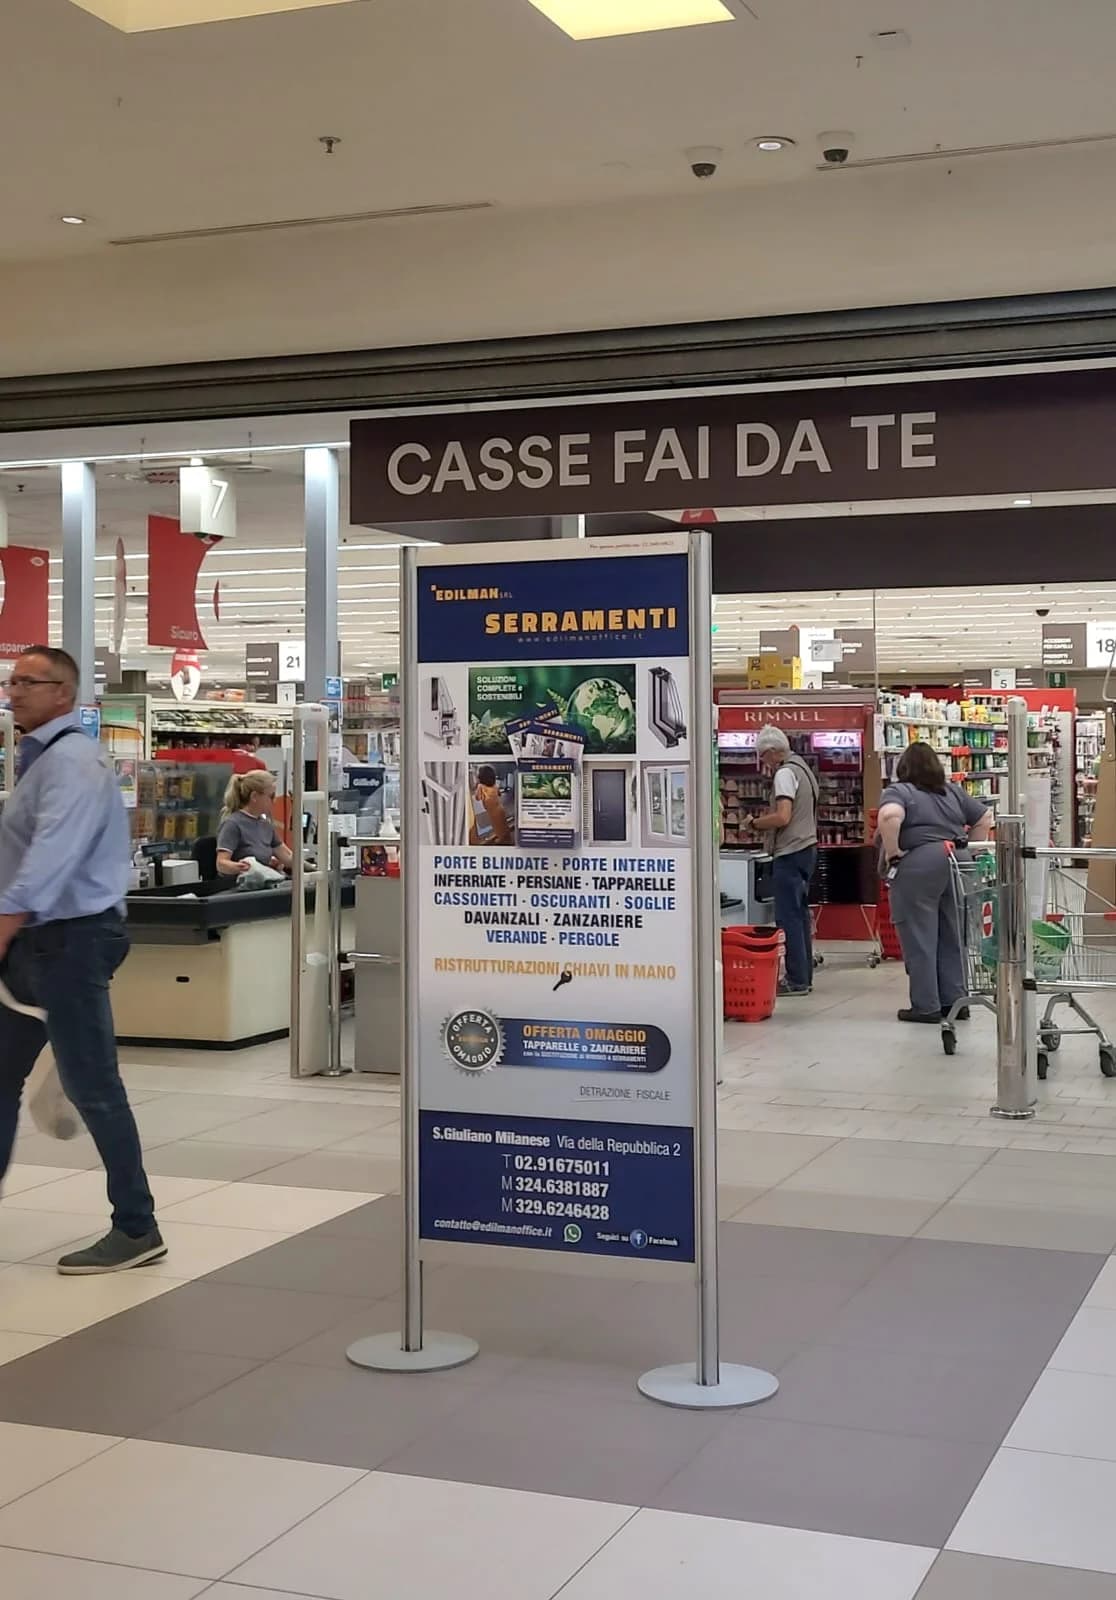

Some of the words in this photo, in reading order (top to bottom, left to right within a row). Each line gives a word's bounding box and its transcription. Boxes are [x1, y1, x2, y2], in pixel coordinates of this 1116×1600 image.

[386, 432, 591, 496] CASSE
[613, 425, 709, 484] FAI
[736, 419, 831, 478] DA
[850, 411, 938, 471] TE
[210, 479, 229, 519] 7
[435, 588, 500, 601] EDILMAN
[484, 607, 677, 634] SERRAMENTI
[286, 656, 301, 668] 21
[476, 675, 517, 684] SOLUZIONI
[476, 684, 517, 692] COMPLETE
[1000, 679, 1008, 689] 5
[476, 693, 523, 701] SOSTENIBILI
[744, 711, 826, 722] RIMMEL
[434, 856, 477, 870] PORTE
[482, 856, 549, 871] BLINDATE
[562, 857, 607, 871] PORTE
[613, 858, 676, 873] INTERNE
[434, 874, 506, 888] INFERRIATE
[517, 875, 582, 890] PERSIANE
[592, 876, 676, 892] TAPPARELLE
[434, 892, 517, 907] CASSONETTI
[531, 894, 610, 909] OSCURANTI
[624, 896, 676, 911] SOGLIE
[464, 911, 540, 926] DAVANZALI
[553, 913, 643, 929] ZANZARIERE
[486, 930, 548, 945] VERANDE
[559, 932, 620, 947] PERGOLE
[434, 957, 560, 976] RISTRUTTURAZIONI
[563, 962, 609, 978] CHIAVI
[615, 963, 628, 978] IN
[633, 964, 676, 980] MANO
[452, 1014, 493, 1034] OFFERTA
[522, 1024, 580, 1039] OFFERTA
[585, 1028, 647, 1043] OMAGGIO
[453, 1045, 492, 1063] OMAGGIO
[522, 1040, 579, 1052] TAPPARELLE
[589, 1043, 647, 1055] ZANZARIERE
[580, 1086, 632, 1099] DETRAZIONE
[636, 1089, 671, 1101] FISCALE
[432, 1126, 492, 1143] S.Giuliano
[495, 1130, 550, 1147] Milanese
[556, 1135, 576, 1149] Via
[578, 1136, 604, 1151] della
[607, 1138, 670, 1157] Repubblica
[673, 1143, 681, 1156] 2
[501, 1154, 512, 1169] T
[514, 1155, 610, 1176] 02.91675011
[501, 1175, 513, 1190] M
[515, 1176, 609, 1198] 324.6381887
[501, 1197, 513, 1212] M
[515, 1198, 610, 1220] 329.6246428
[434, 1218, 552, 1238] contatto@edilmanoffice.it
[648, 1236, 678, 1247] Facebook
